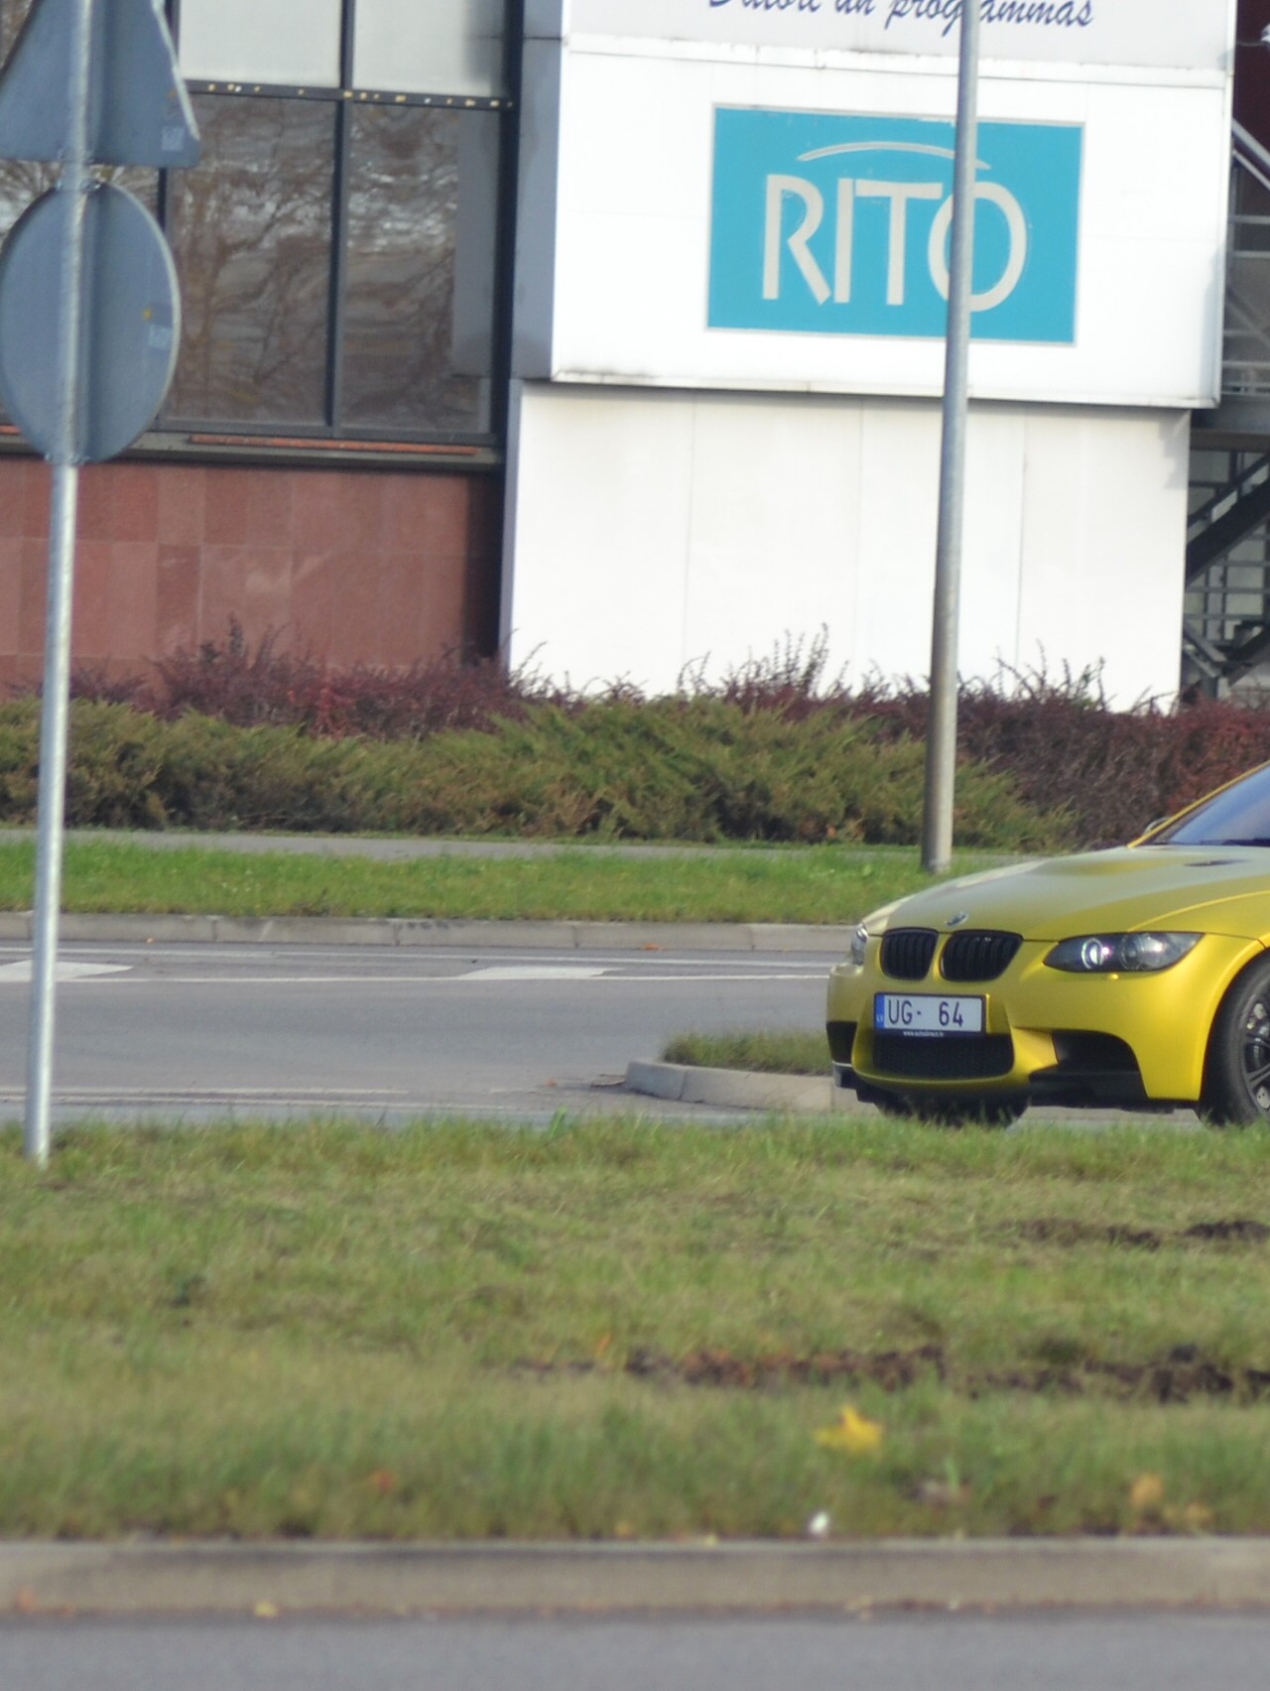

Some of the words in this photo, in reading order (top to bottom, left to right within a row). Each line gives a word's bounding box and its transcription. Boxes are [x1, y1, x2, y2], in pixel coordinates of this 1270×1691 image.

[884, 0, 1093, 37] progammas
[763, 174, 1027, 312] RITO
[938, 1001, 964, 1027] 64
